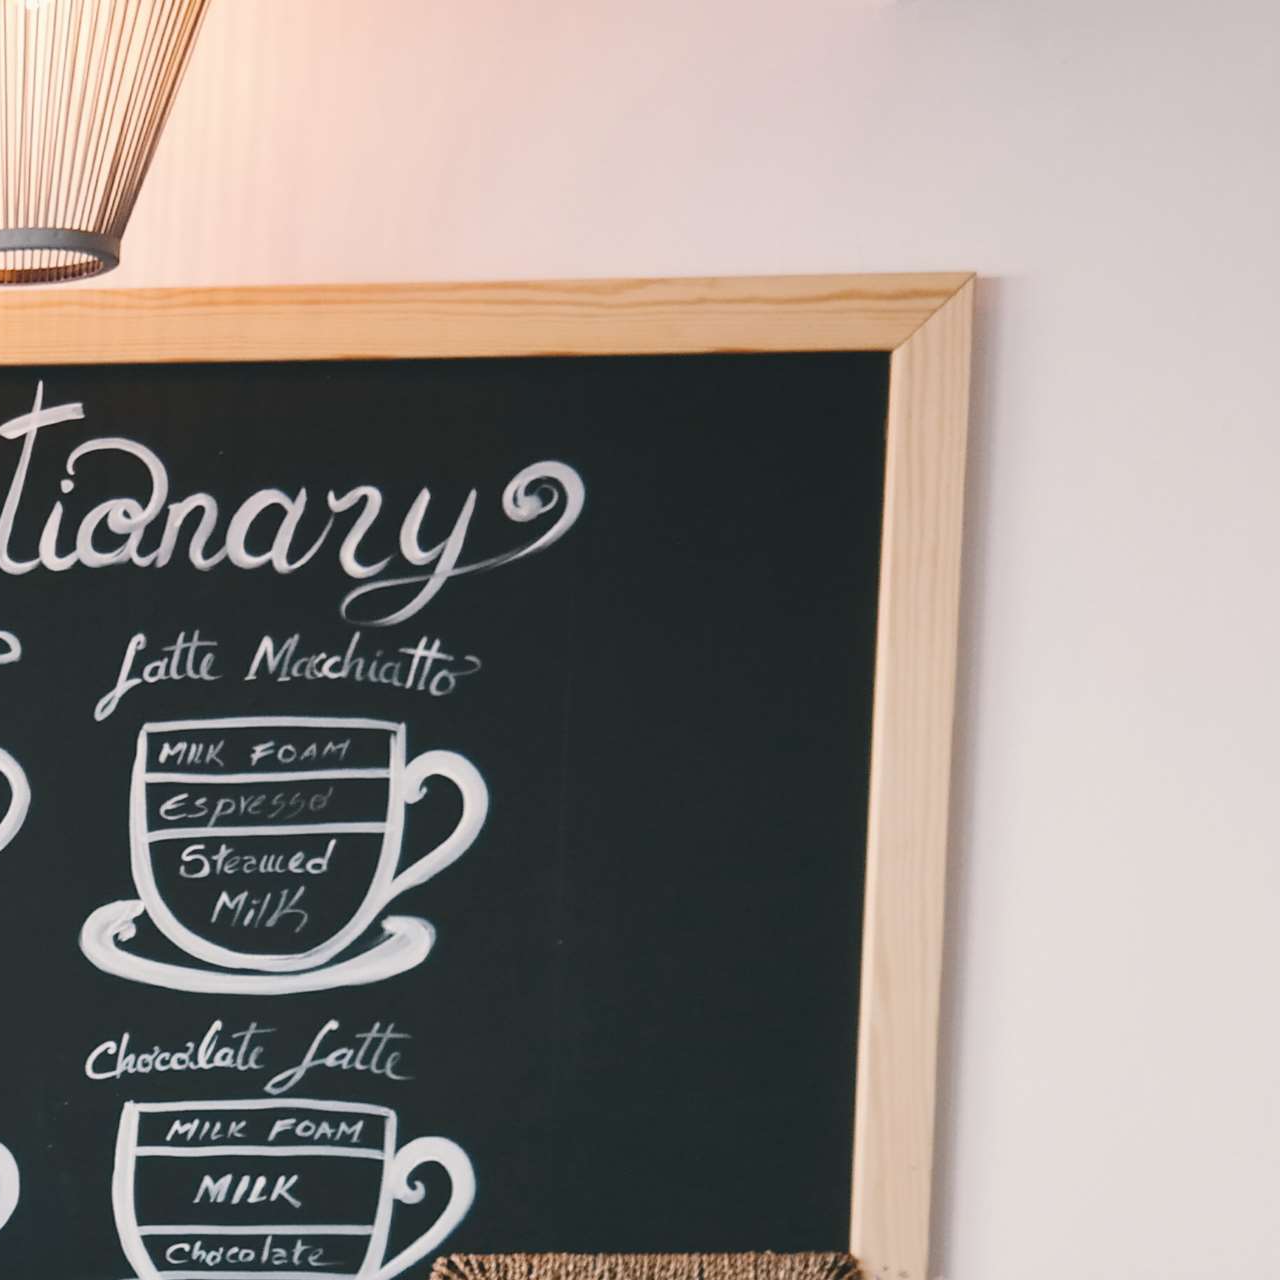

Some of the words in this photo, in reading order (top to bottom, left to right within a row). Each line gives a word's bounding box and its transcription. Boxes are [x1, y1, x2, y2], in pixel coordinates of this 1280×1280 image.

[94, 630, 223, 721] Latte
[157, 740, 225, 767] MILK
[250, 739, 351, 766] FOAM
[159, 787, 333, 828] Espresso
[178, 838, 336, 878] Steamed
[211, 885, 308, 932] Milk
[84, 1019, 276, 1080] Chocolate
[264, 1018, 414, 1095] Latte
[165, 1117, 246, 1142] MILK
[267, 1116, 365, 1144] FOAM
[192, 1173, 303, 1208] MILK
[164, 1235, 341, 1268] Chocolate
